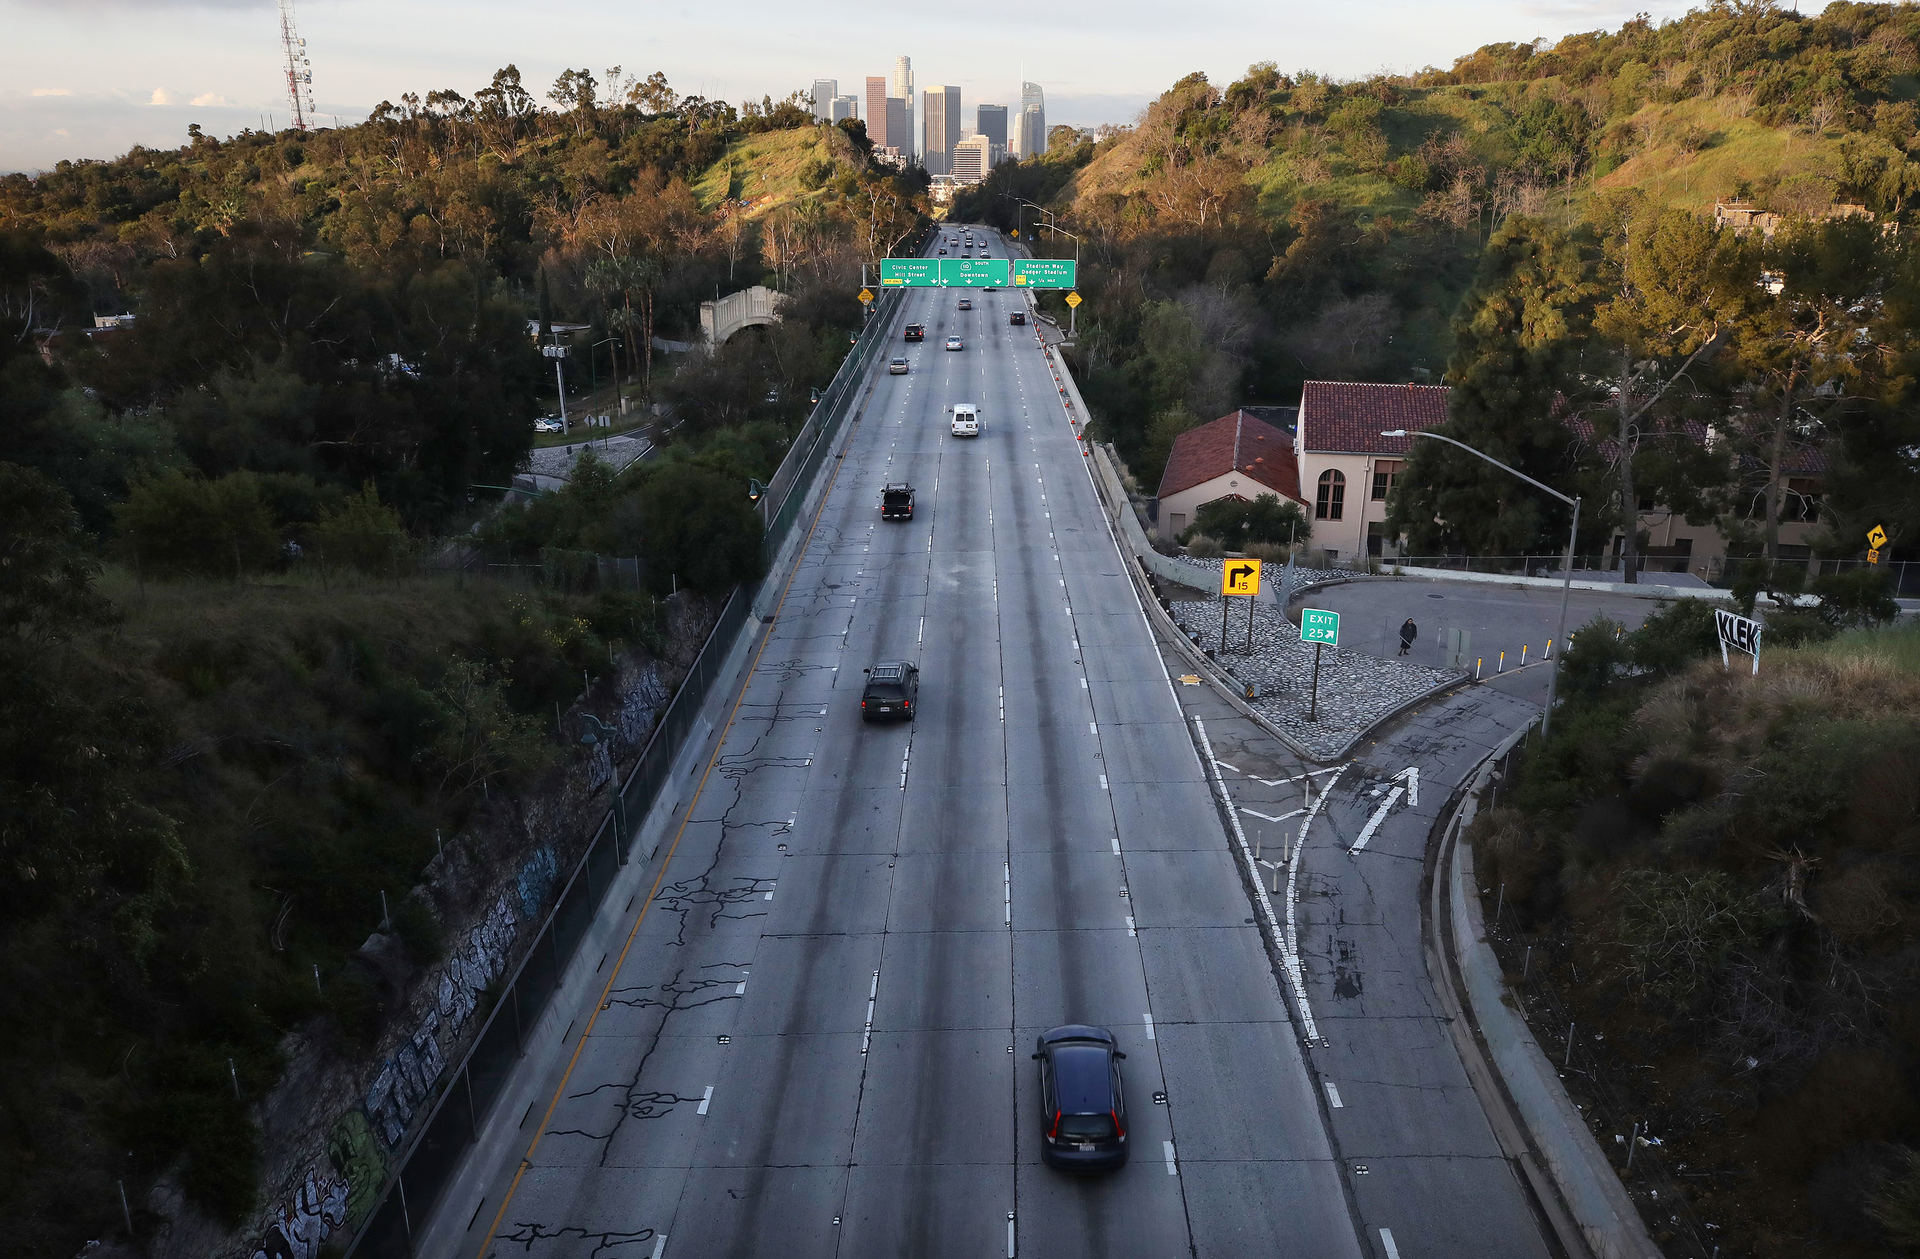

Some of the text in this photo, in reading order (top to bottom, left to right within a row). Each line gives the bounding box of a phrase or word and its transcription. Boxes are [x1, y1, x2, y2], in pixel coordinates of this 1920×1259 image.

[1238, 582, 1248, 590] 15
[1309, 614, 1334, 626] EXIT
[1308, 628, 1324, 638] 25
[1716, 610, 1759, 656] KLEK
